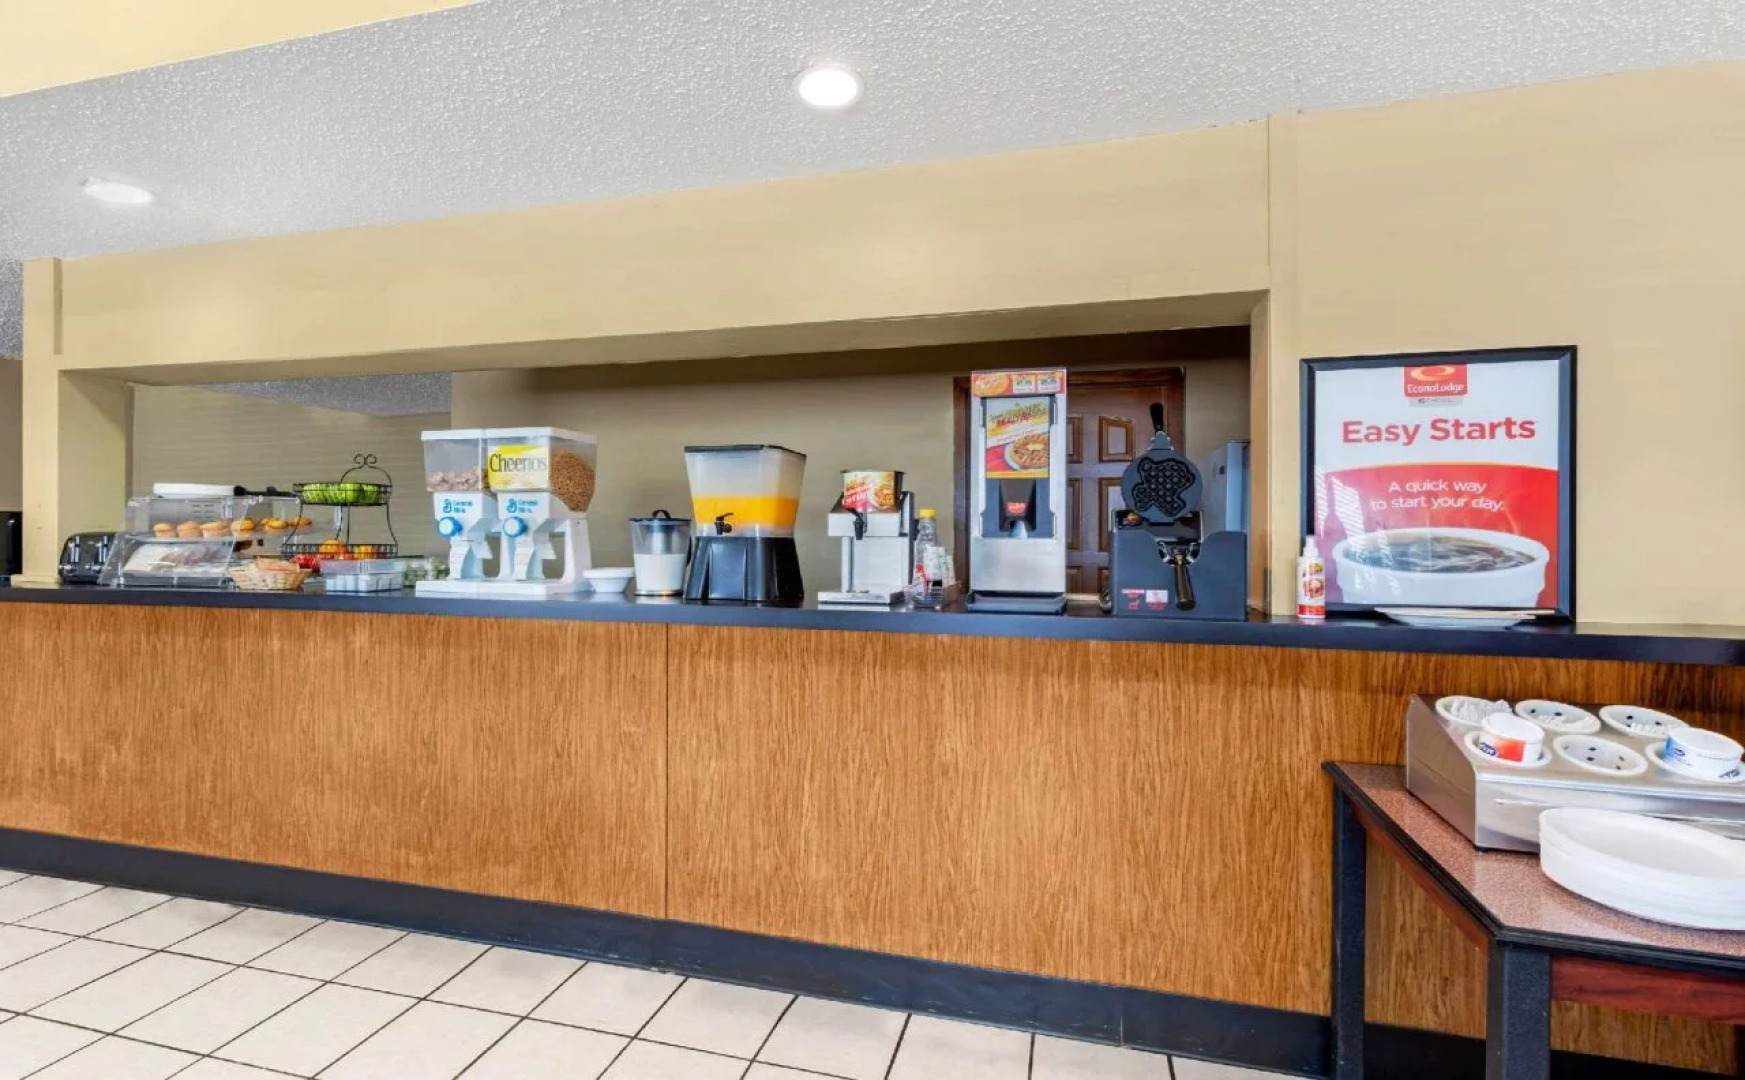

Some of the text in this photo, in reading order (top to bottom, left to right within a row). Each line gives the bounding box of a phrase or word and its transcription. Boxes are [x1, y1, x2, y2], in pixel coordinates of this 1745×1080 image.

[1407, 383, 1465, 394] EconoLodge
[1342, 417, 1536, 446] Easy Starts
[489, 453, 546, 472] Cheerios
[1388, 479, 1487, 495] A quick way
[1370, 496, 1505, 512] to start your day.
